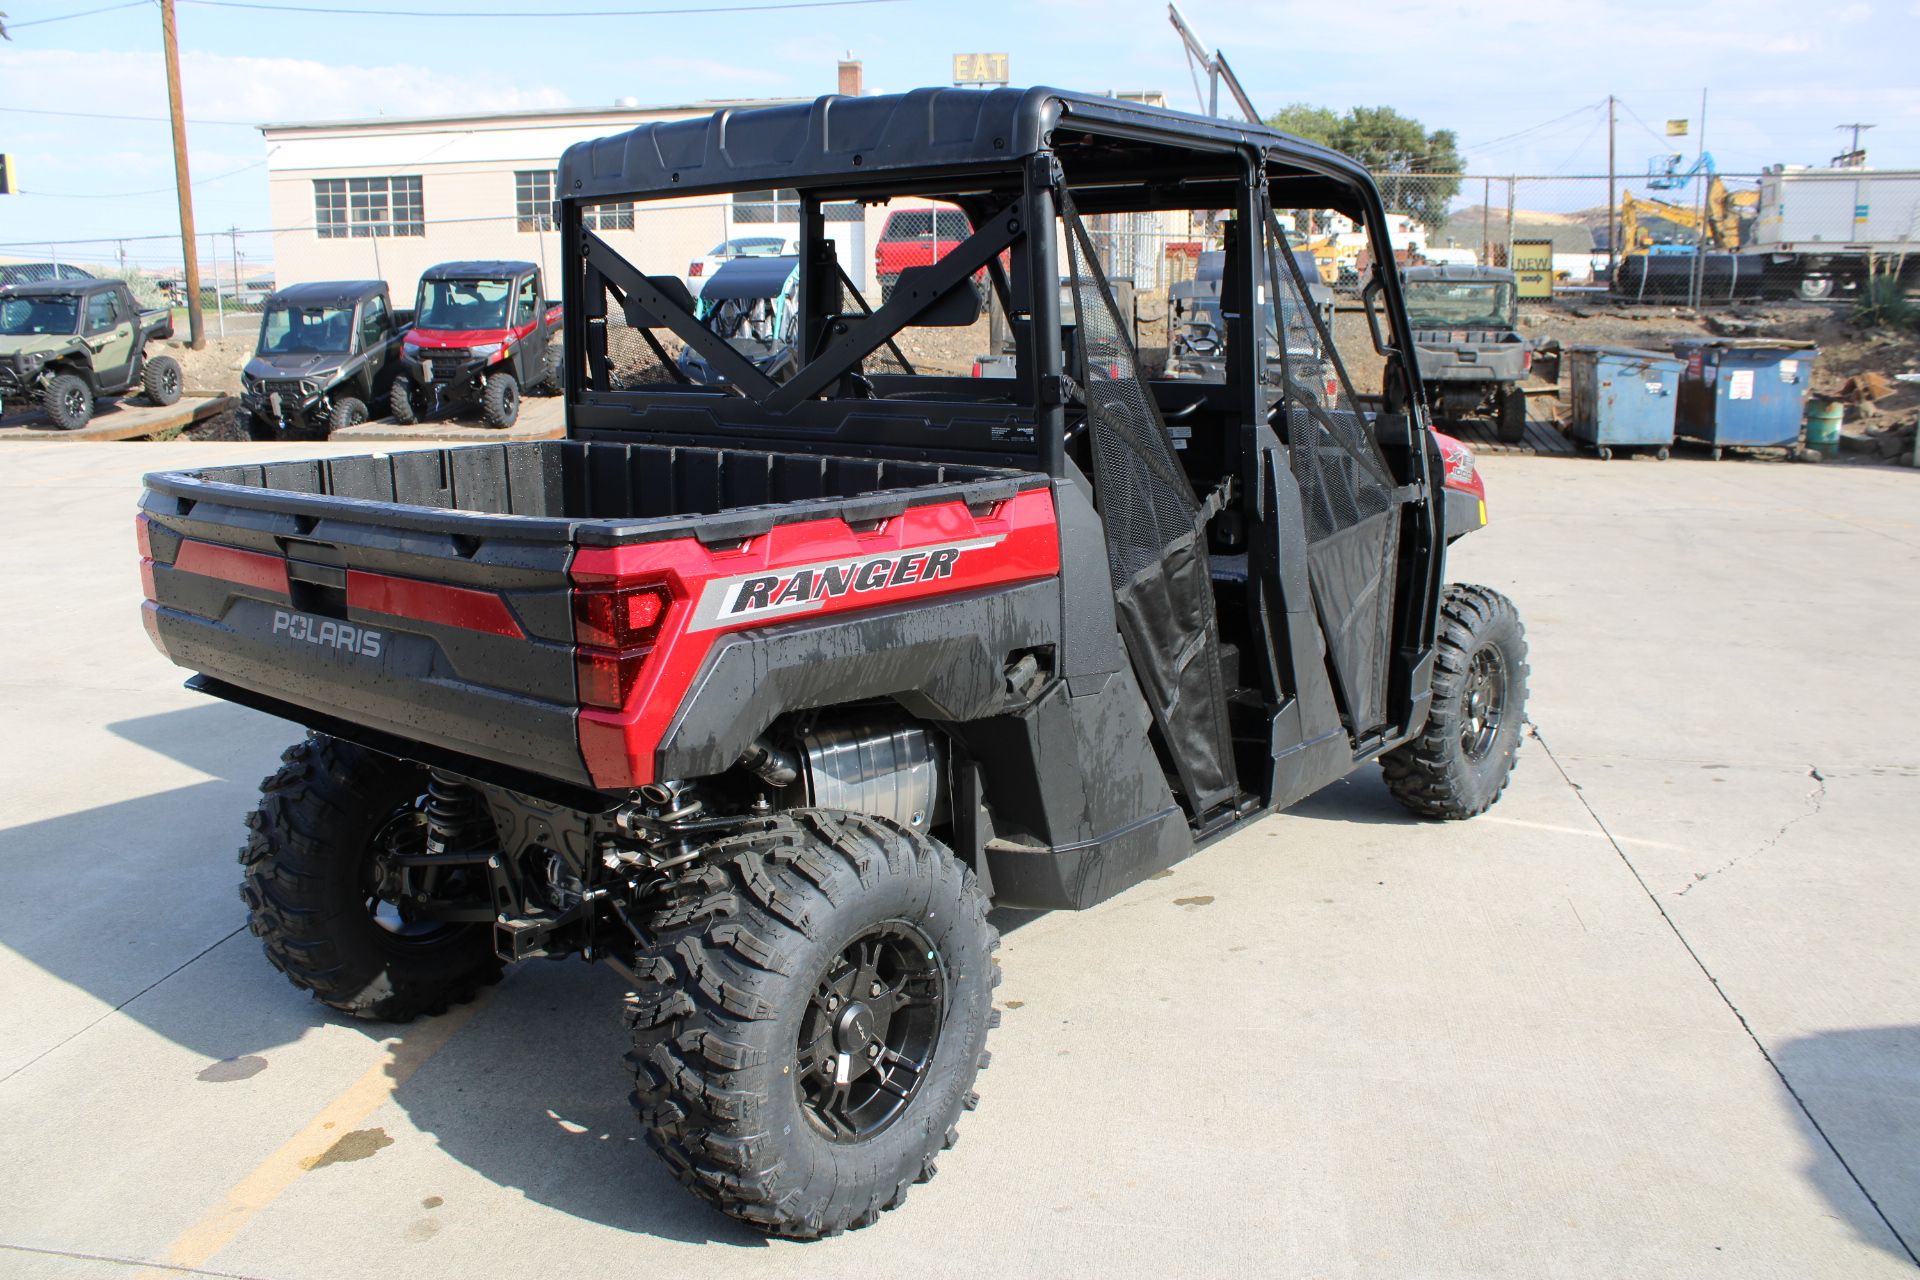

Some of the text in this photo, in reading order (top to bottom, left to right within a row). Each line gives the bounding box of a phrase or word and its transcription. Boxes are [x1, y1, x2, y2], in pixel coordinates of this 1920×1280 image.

[955, 54, 1007, 80] EAT
[1517, 257, 1549, 270] NEW
[729, 547, 960, 614] RANGER
[272, 610, 382, 658] POLARIS
